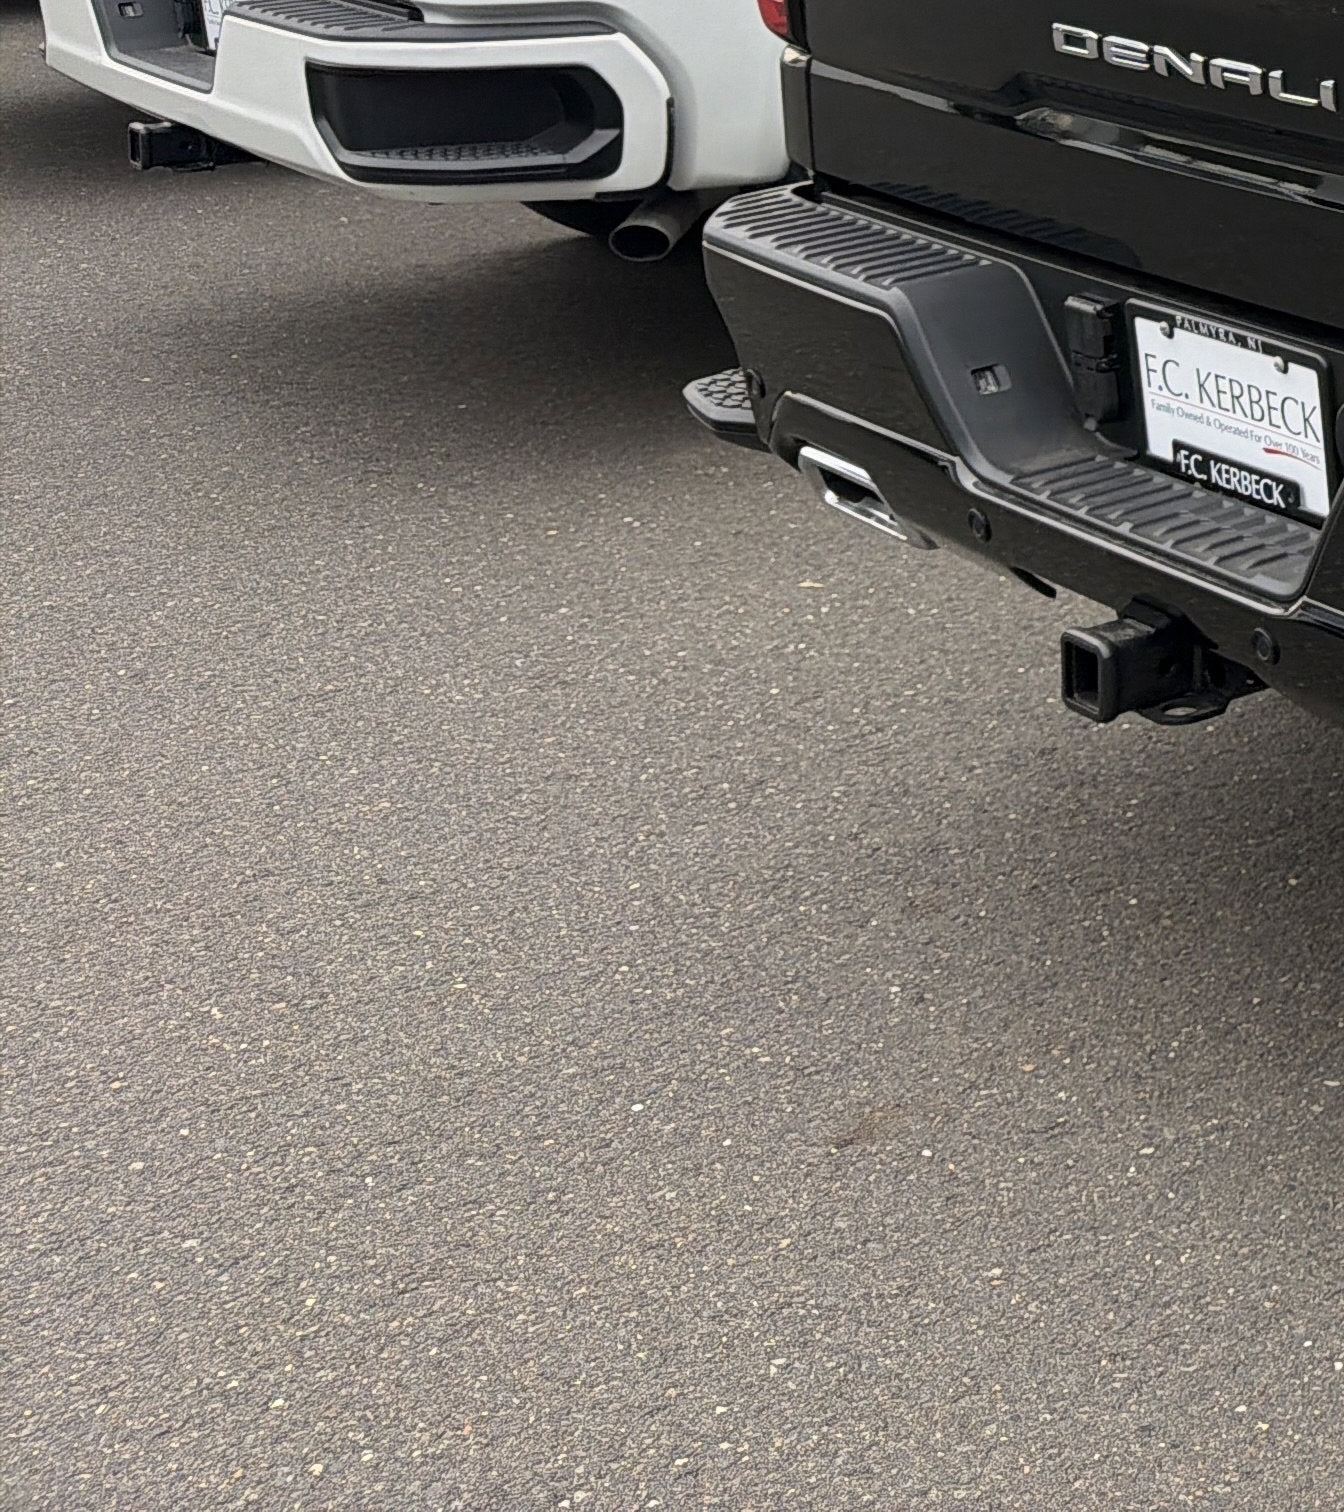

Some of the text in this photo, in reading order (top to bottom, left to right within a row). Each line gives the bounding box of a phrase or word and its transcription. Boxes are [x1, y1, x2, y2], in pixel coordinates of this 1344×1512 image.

[1052, 22, 1338, 112] DENALI
[1144, 353, 1321, 444] F.C. KERBECK
[1151, 399, 1321, 465] Family Owned & Operated For Over 100 Years
[1179, 450, 1287, 509] F.C. KERBECK
